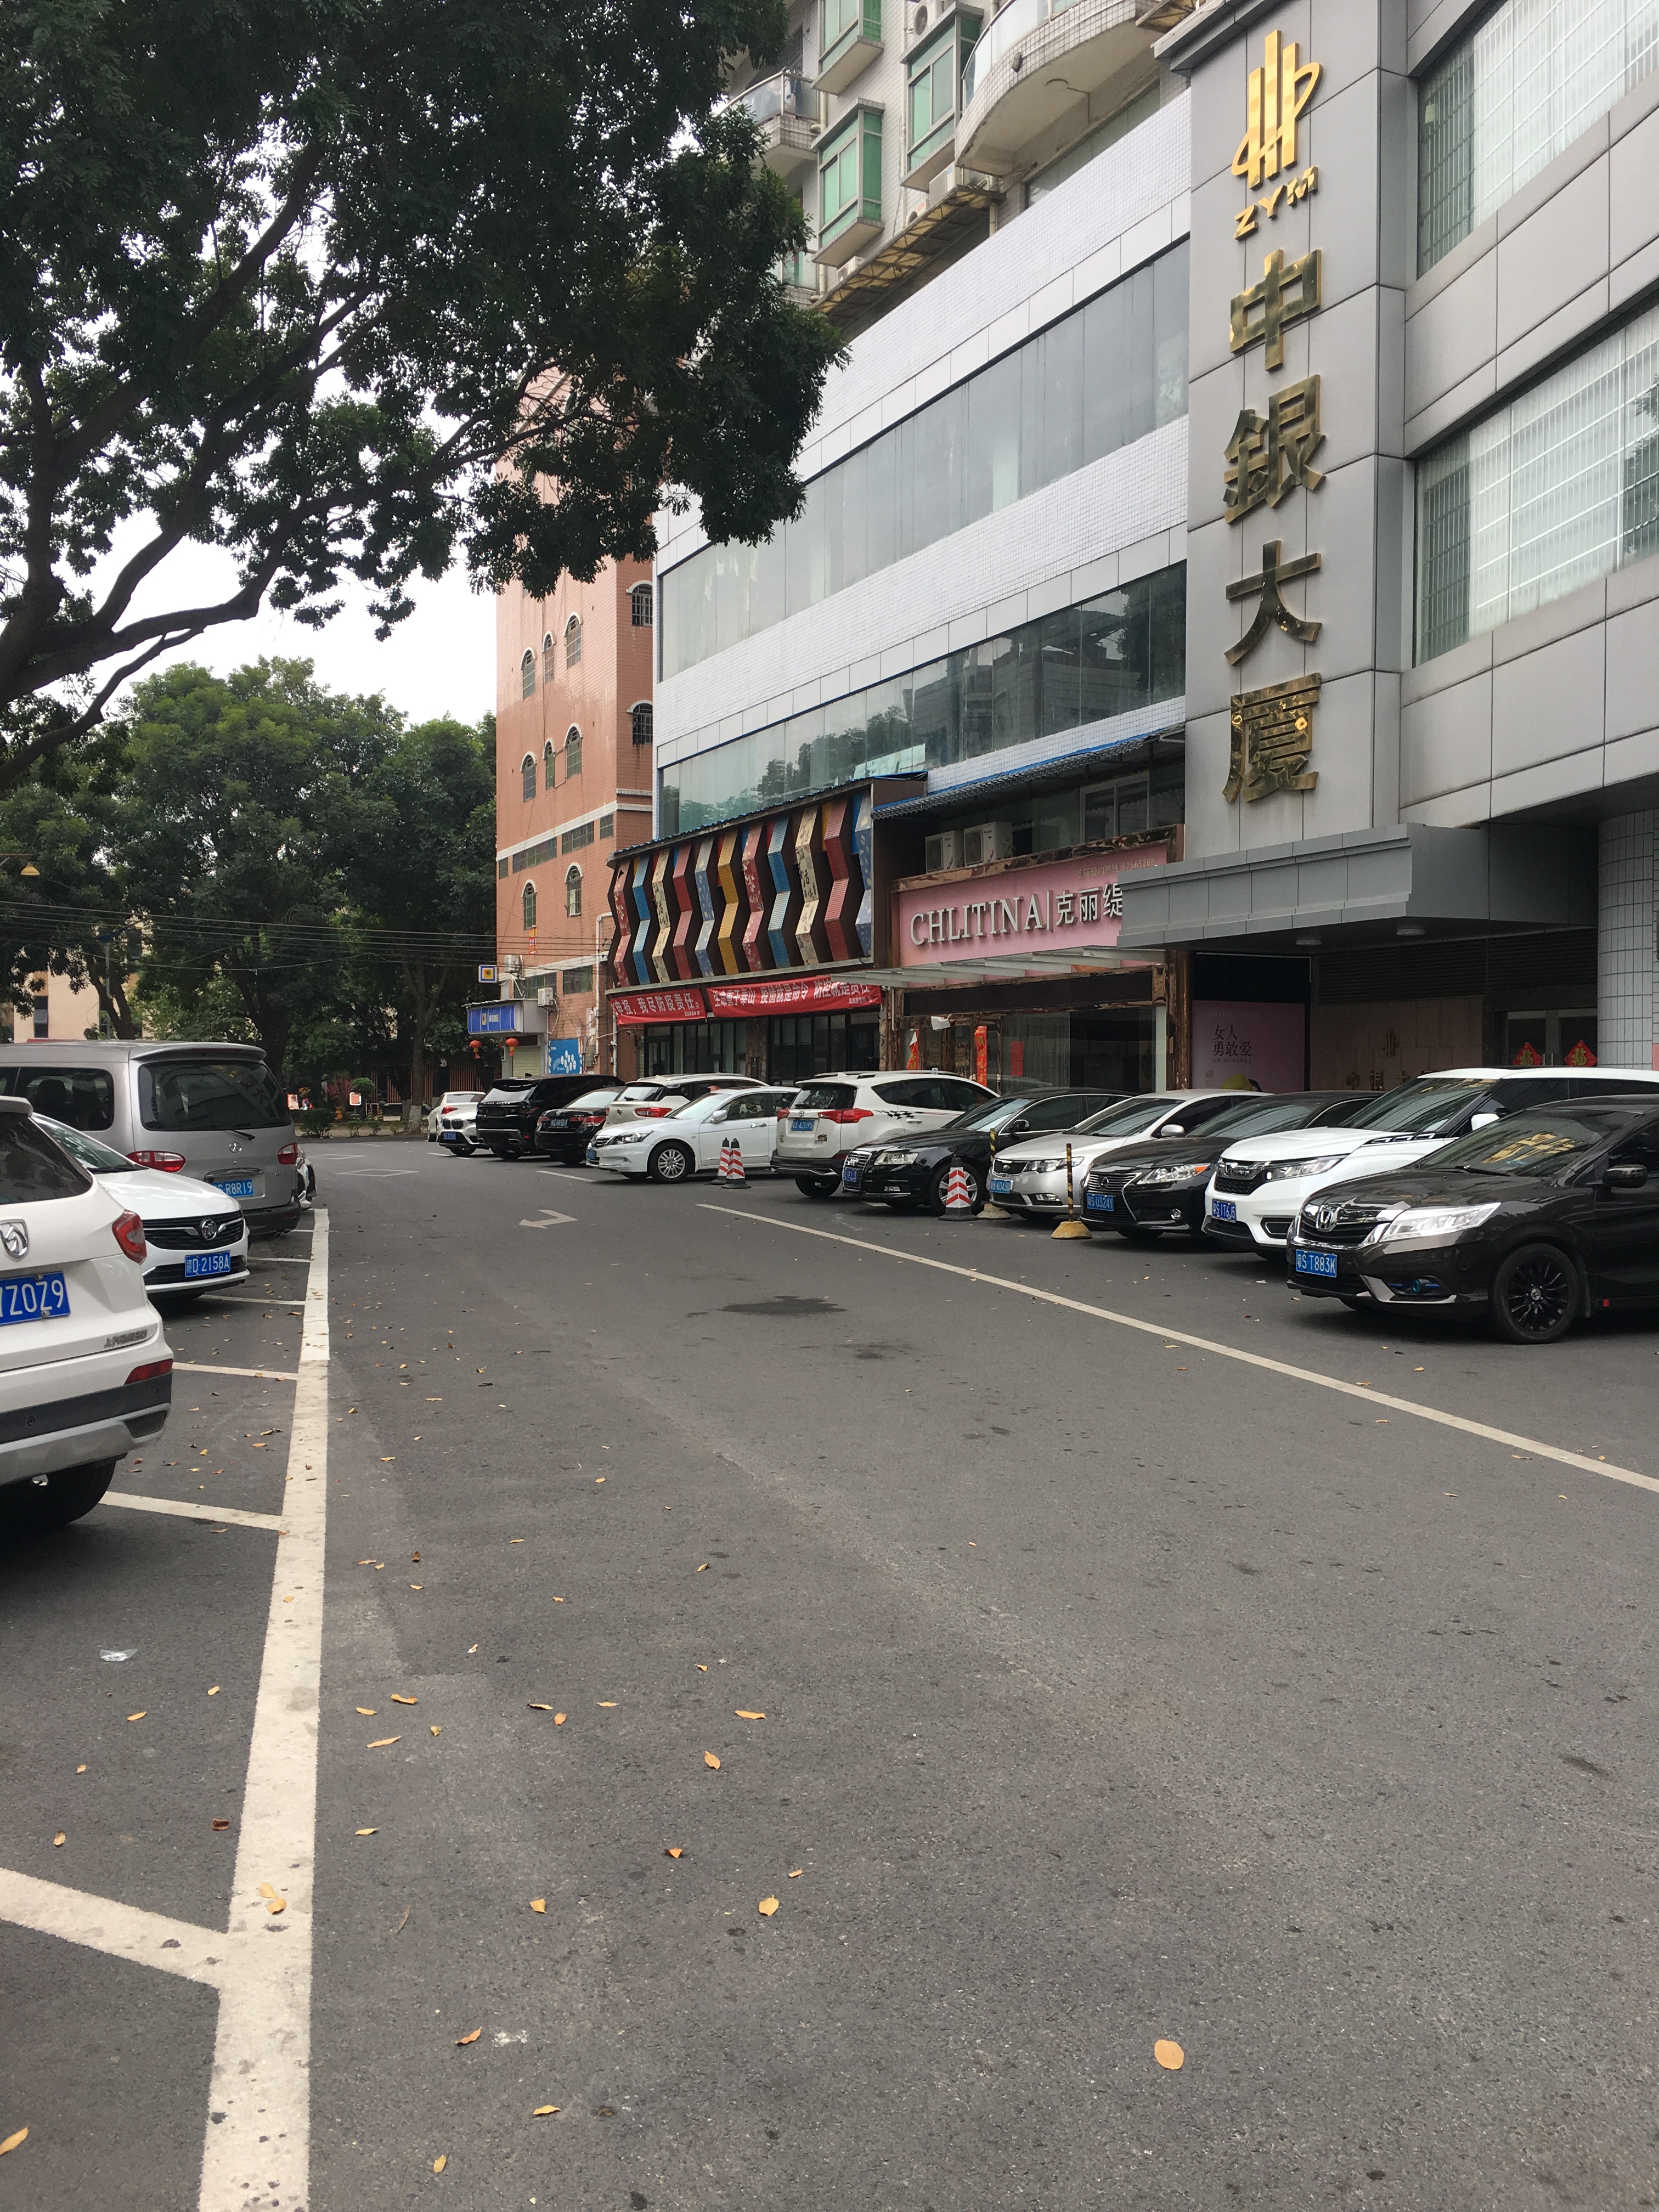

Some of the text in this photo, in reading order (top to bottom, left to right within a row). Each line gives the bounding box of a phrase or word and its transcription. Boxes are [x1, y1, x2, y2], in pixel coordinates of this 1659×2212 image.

[1233, 166, 1319, 240] ZYM
[1122, 857, 1155, 871] 87565288
[910, 893, 1046, 946] CHLITINA
[713, 987, 755, 1007] 生命重于泰山
[760, 981, 809, 1003] 疫情就是命令
[1212, 1024, 1238, 1040] 女人
[1212, 1040, 1252, 1057] 勇敢爱
[1571, 1047, 1588, 1066] 福
[1519, 1049, 1534, 1066] 福
[214, 1181, 252, 1195] S·R8R19
